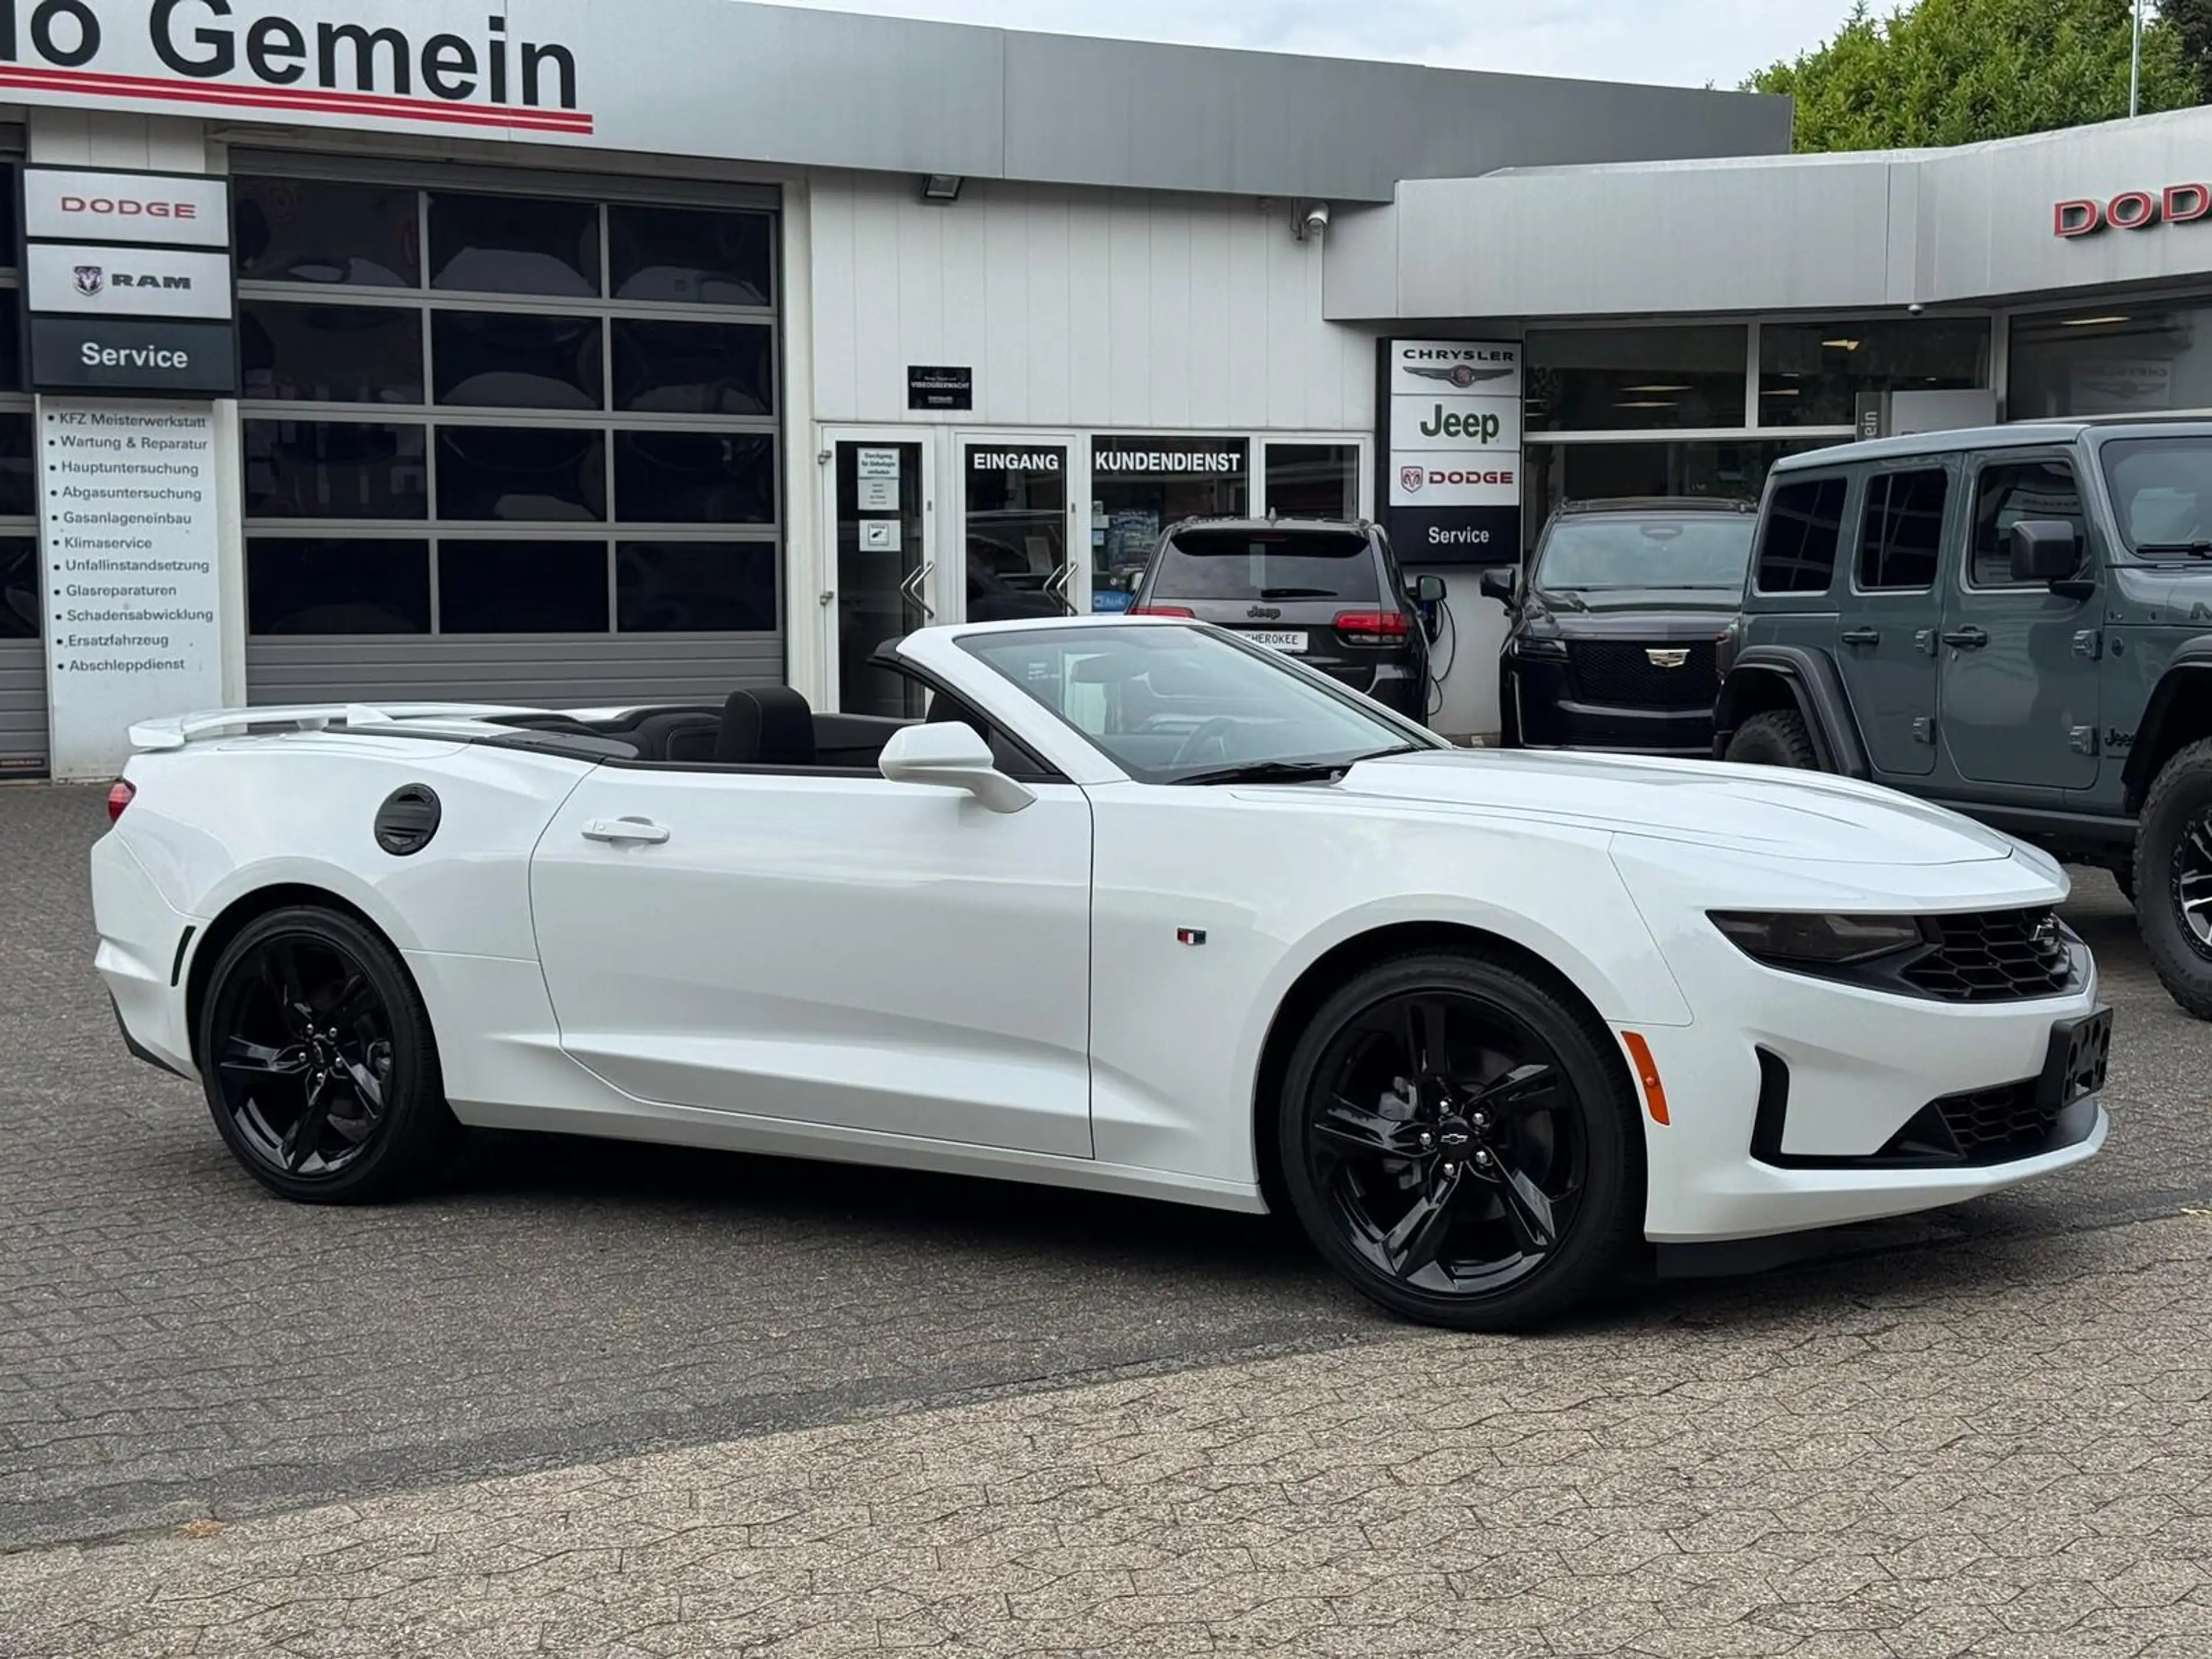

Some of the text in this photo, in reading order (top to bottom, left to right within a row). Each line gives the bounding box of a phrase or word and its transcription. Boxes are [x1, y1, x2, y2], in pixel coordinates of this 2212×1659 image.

[149, 0, 576, 109] Gemein
[62, 196, 196, 219] DODGE
[111, 274, 191, 290] RAM
[81, 342, 188, 369] Service
[1403, 349, 1514, 362] CHRYSLER
[59, 412, 206, 428] KFZ Meisterwerkstatt
[1420, 404, 1499, 444] Jeep
[60, 435, 207, 452] Wartung & Reparatur
[974, 453, 1059, 470] EINGANG
[1096, 452, 1241, 471] KUNDENDIENST
[61, 461, 199, 478] Hauptuntersuchung
[1429, 471, 1514, 484] DODGE
[62, 487, 202, 502] Abgasuntersuchung
[63, 512, 191, 526] Gasanlageneinbau
[65, 536, 152, 549] Klimaservice
[1428, 527, 1490, 544] Service
[66, 559, 210, 573] Unfallinstandsetzung
[66, 585, 176, 598] Glasreparaturen
[67, 609, 214, 623] Schadensabwicklung
[1247, 605, 1281, 620] Jeep
[68, 635, 169, 648] Ersatzfahrzeug
[69, 660, 184, 673] Abschleppdienst
